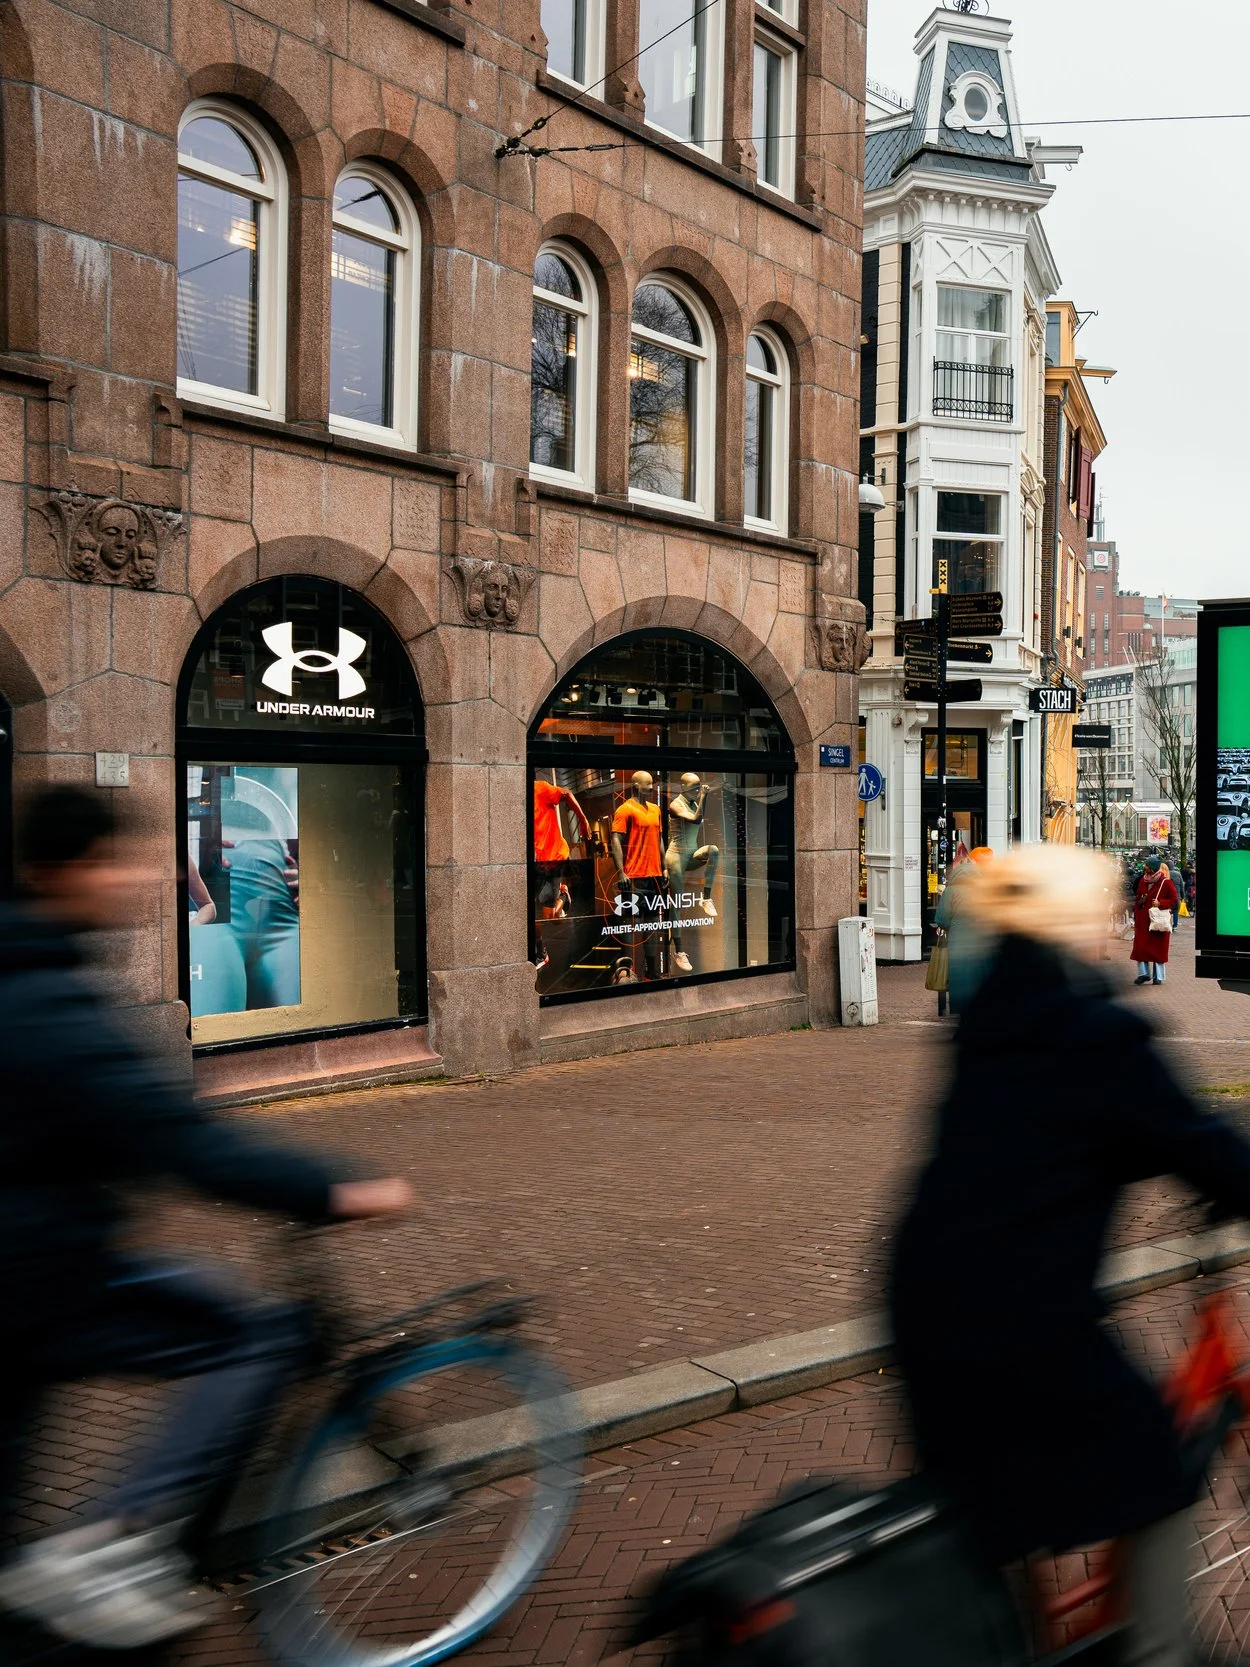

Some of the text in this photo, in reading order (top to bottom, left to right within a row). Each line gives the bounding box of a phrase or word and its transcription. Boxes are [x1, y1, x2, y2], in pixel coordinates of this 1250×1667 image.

[1039, 690, 1072, 709] STACH
[256, 701, 375, 719] UNDER ARMOUR
[100, 755, 125, 768] 429
[828, 748, 844, 757] SINGEL
[100, 771, 125, 785] 435
[644, 892, 704, 911] VANISH
[601, 917, 714, 936] ATHLETE-APPROVED INNOVATION
